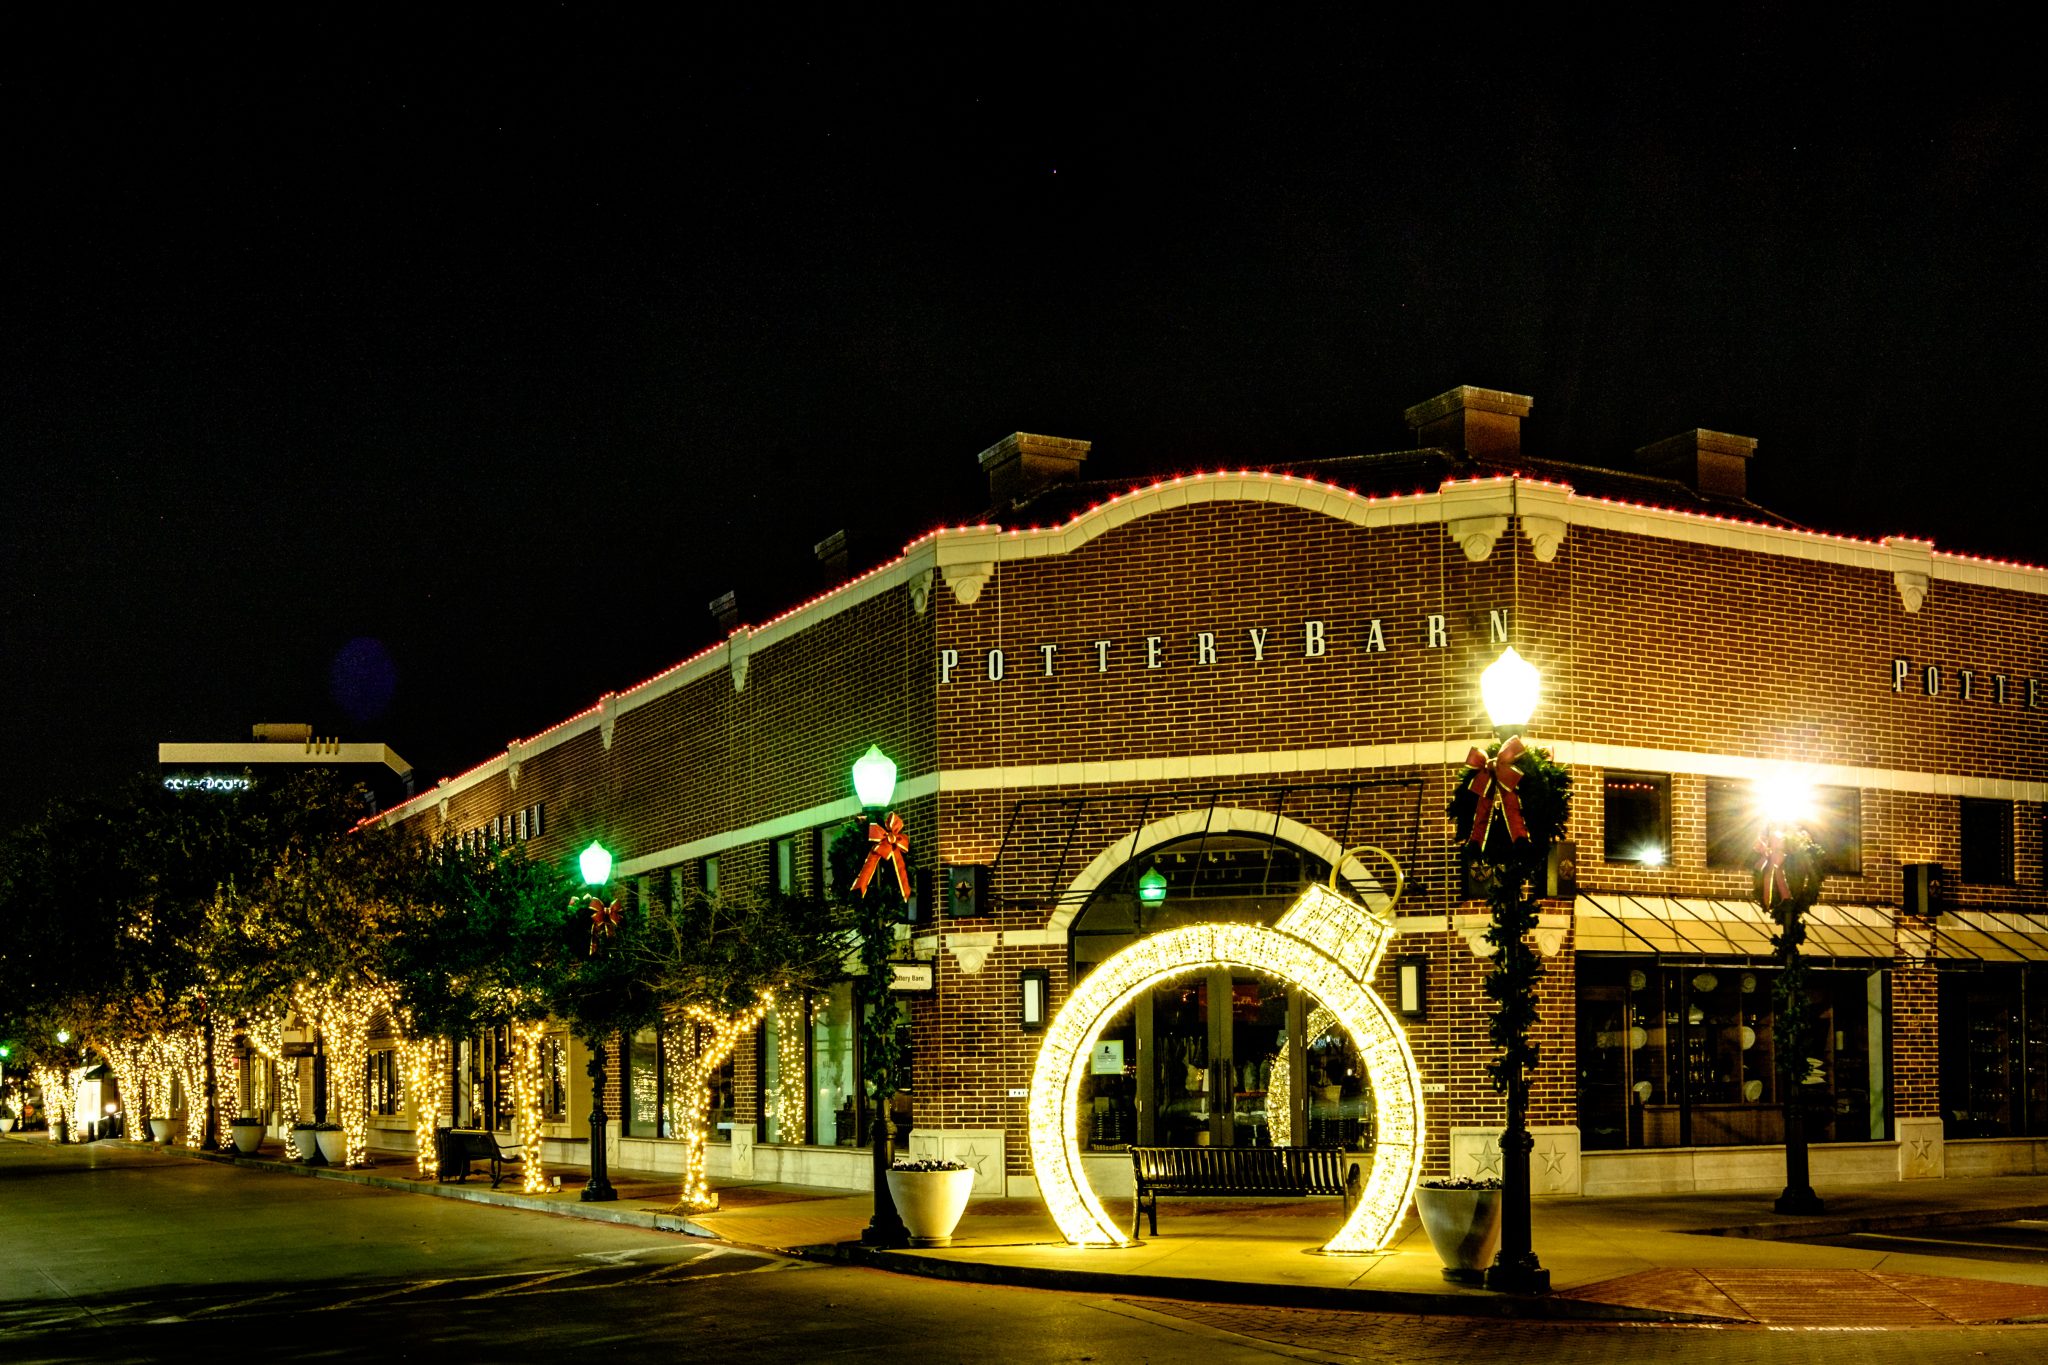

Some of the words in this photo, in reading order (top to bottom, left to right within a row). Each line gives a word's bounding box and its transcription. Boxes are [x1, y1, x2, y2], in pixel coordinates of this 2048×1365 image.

[941, 628, 1267, 684] POTTERY
[1304, 609, 1512, 657] BARN
[1894, 659, 2038, 707] POTTE
